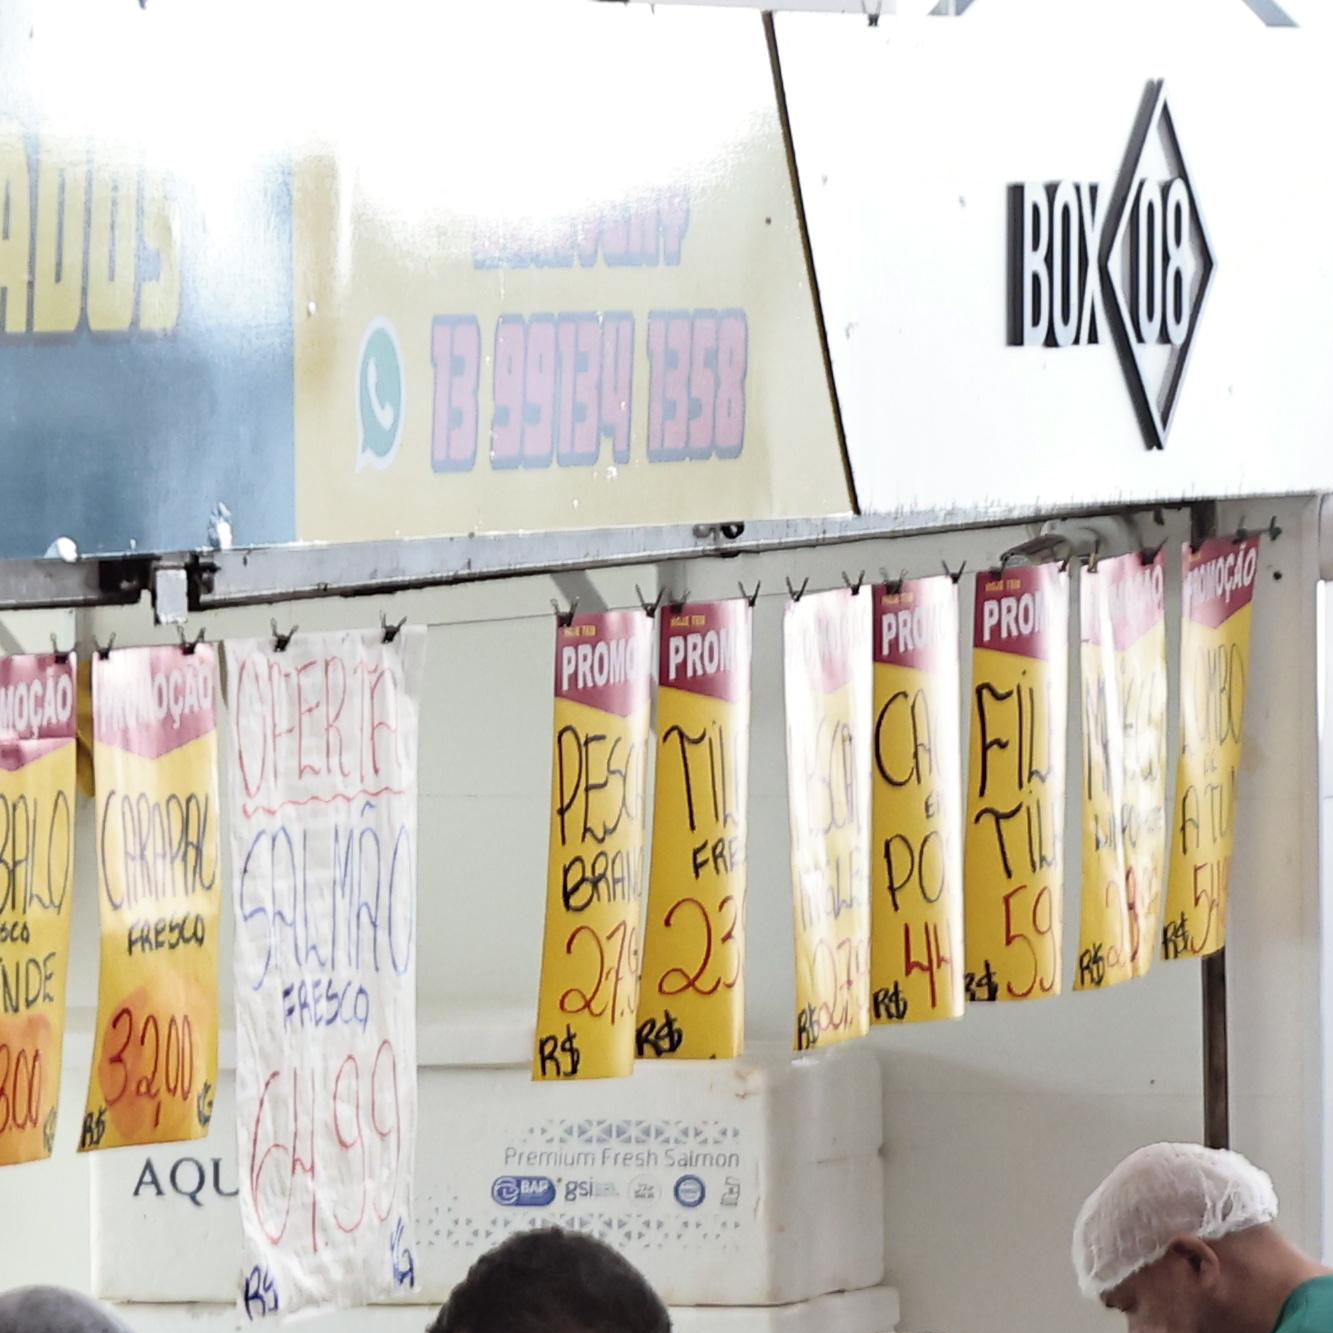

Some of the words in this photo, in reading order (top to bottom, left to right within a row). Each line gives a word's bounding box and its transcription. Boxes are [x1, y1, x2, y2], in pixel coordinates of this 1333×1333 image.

[1006, 180, 1103, 348] BOX
[1132, 176, 1192, 347] 08
[430, 313, 482, 474] 13
[490, 308, 636, 471] 99134
[646, 306, 749, 464] 1358
[236, 655, 403, 799] OFERTA
[239, 799, 413, 993] SALMÃO
[127, 913, 206, 957] FRESCO
[282, 976, 370, 1035] FRESCO
[872, 980, 909, 1020] R$
[539, 1024, 581, 1077] R$
[634, 1008, 684, 1057] R$
[80, 1103, 108, 1148] R$
[133, 1156, 240, 1208] AQU
[503, 1146, 596, 1168] Premium
[600, 1146, 659, 1168] Fresh
[664, 1148, 741, 1169] Salmon
[520, 1179, 549, 1194] BAP
